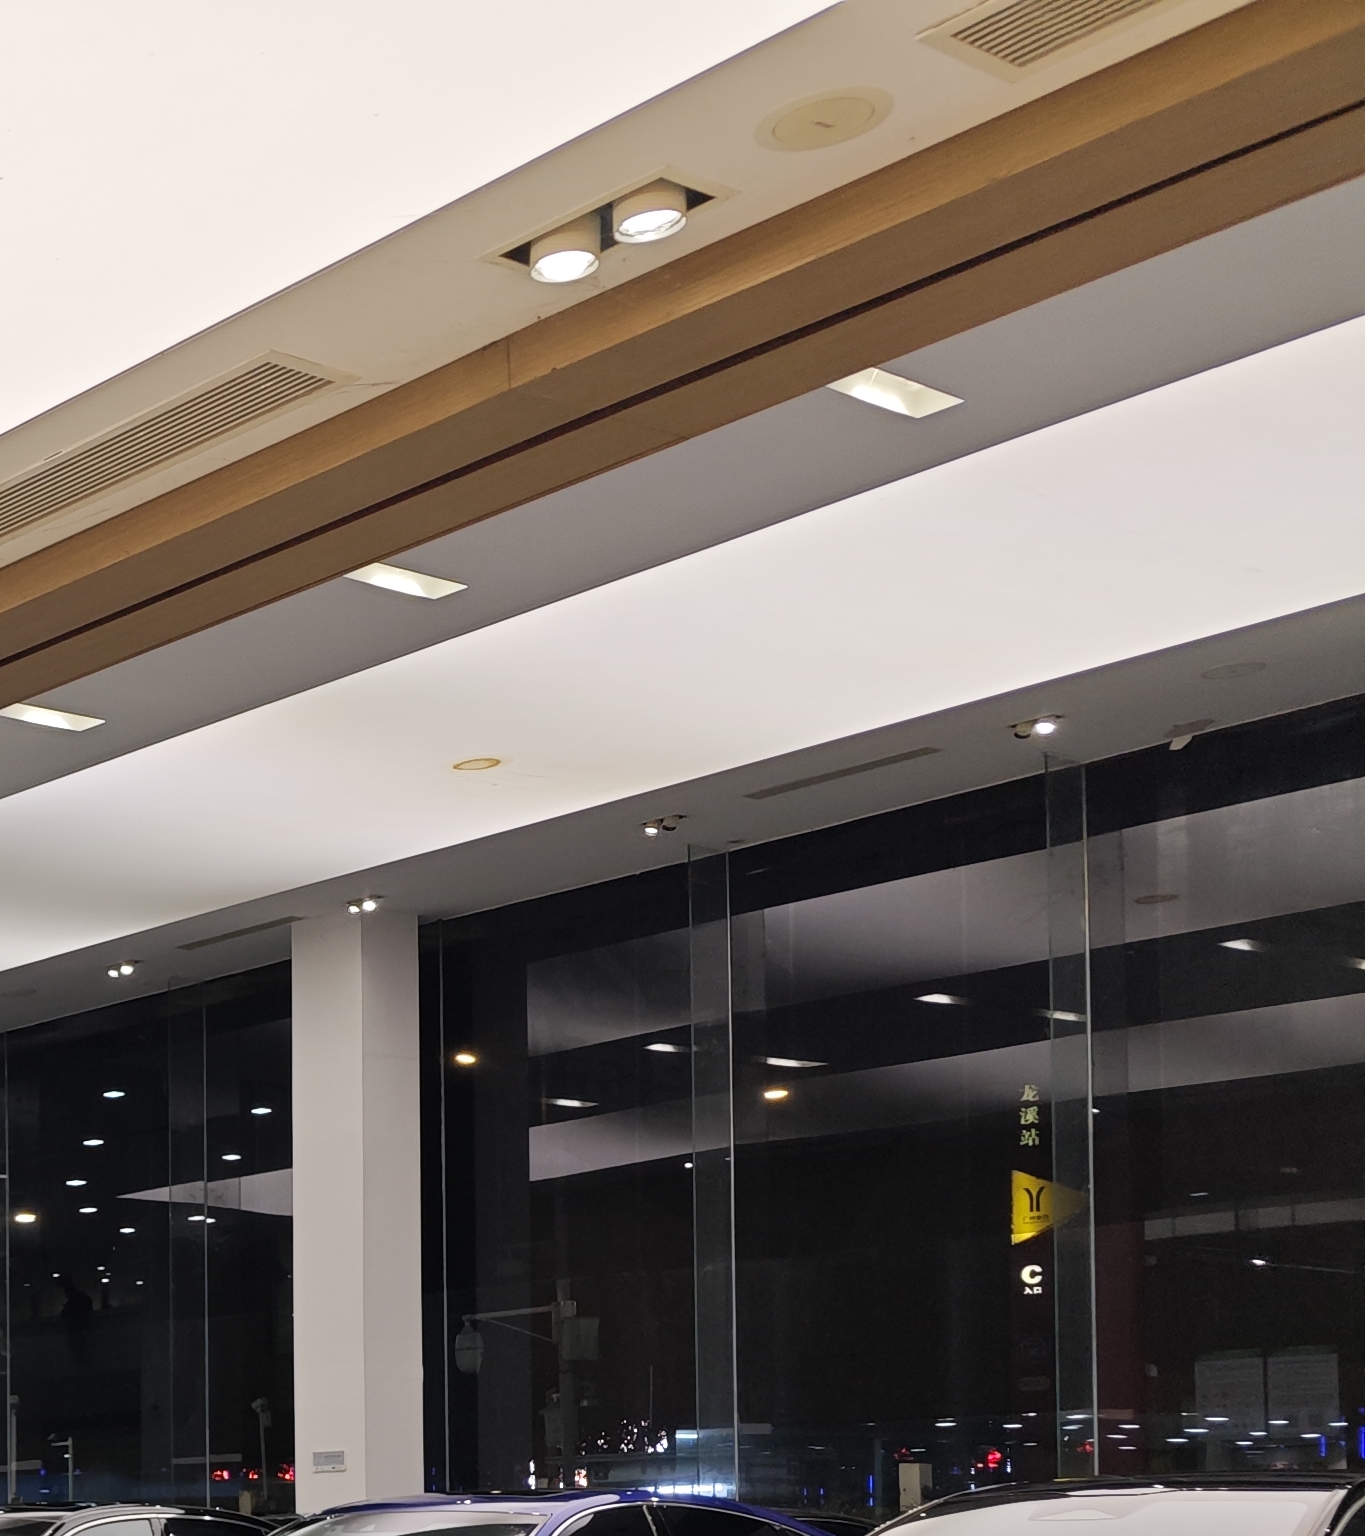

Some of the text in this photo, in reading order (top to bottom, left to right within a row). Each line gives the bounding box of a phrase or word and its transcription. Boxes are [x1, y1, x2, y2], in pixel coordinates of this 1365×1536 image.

[1020, 1084, 1040, 1147] 龙溪站
[1021, 1264, 1043, 1285] C
[1023, 1286, 1043, 1295] 入口
